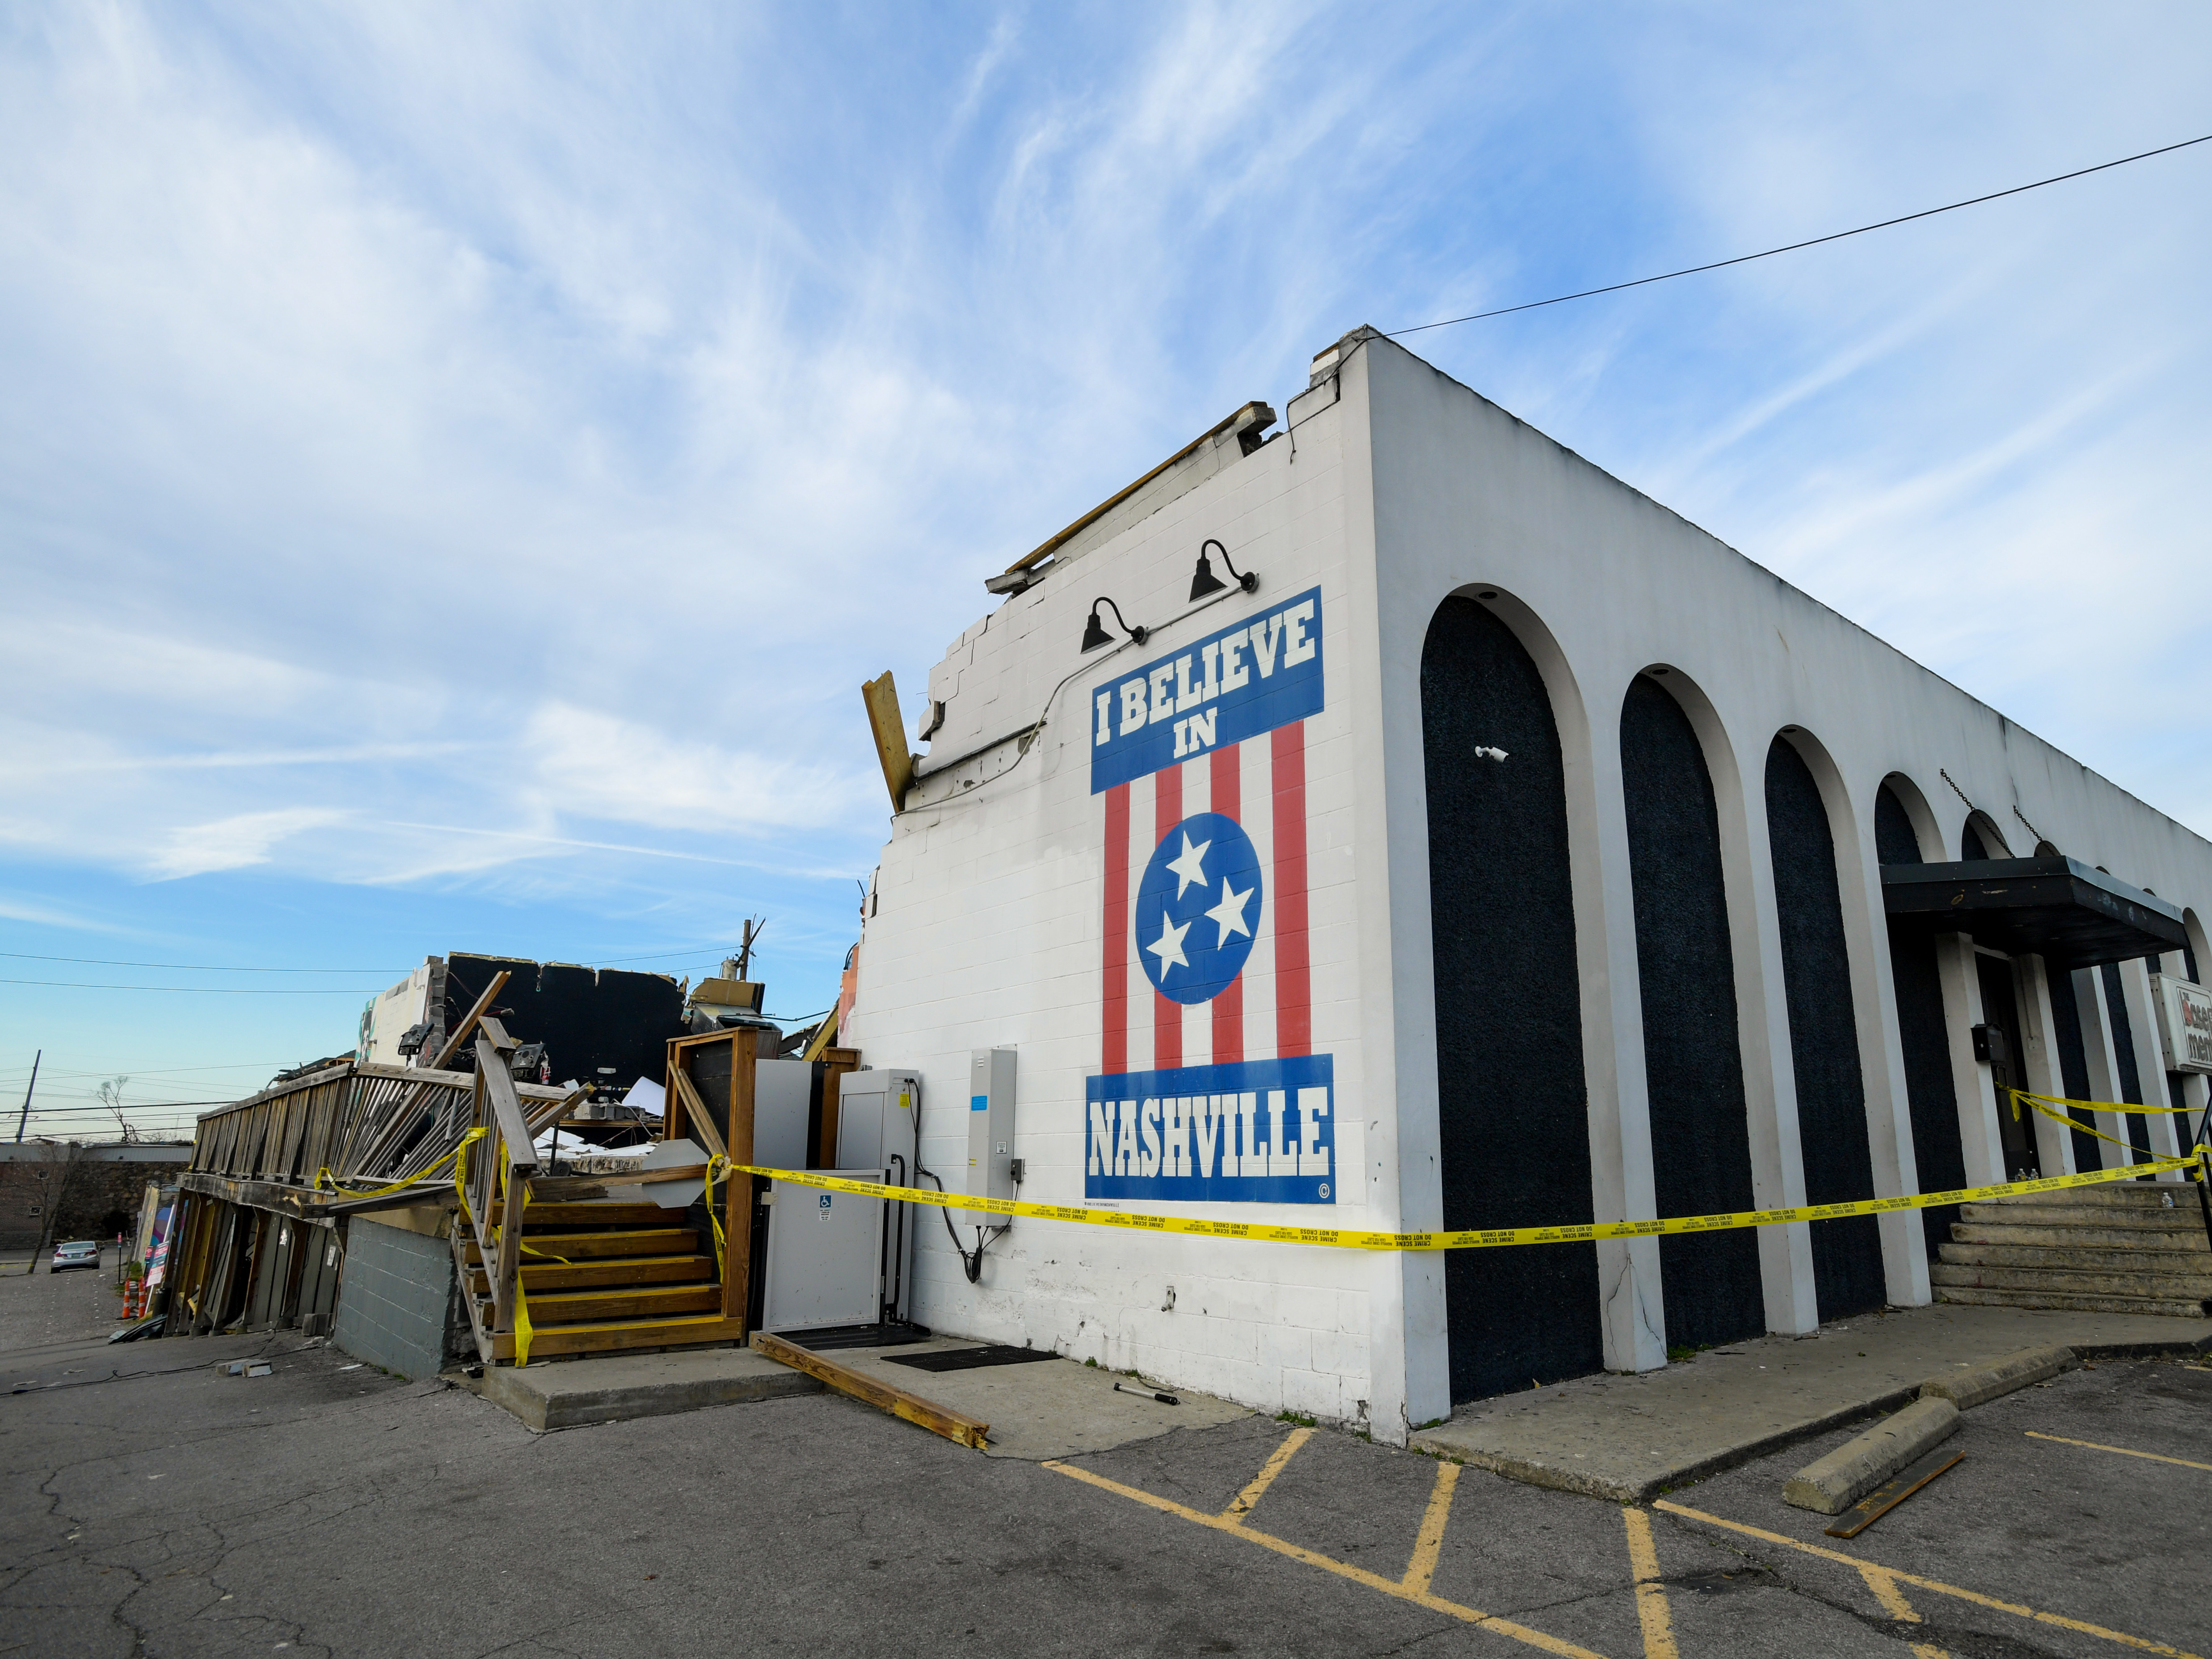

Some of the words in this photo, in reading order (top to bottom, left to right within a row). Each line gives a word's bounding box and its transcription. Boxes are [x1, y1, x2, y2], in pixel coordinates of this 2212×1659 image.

[1096, 691, 1110, 747] I
[1120, 598, 1315, 737] BELIEVE
[1173, 706, 1218, 759] IN
[1089, 1086, 1329, 1178] NASHVILLE
